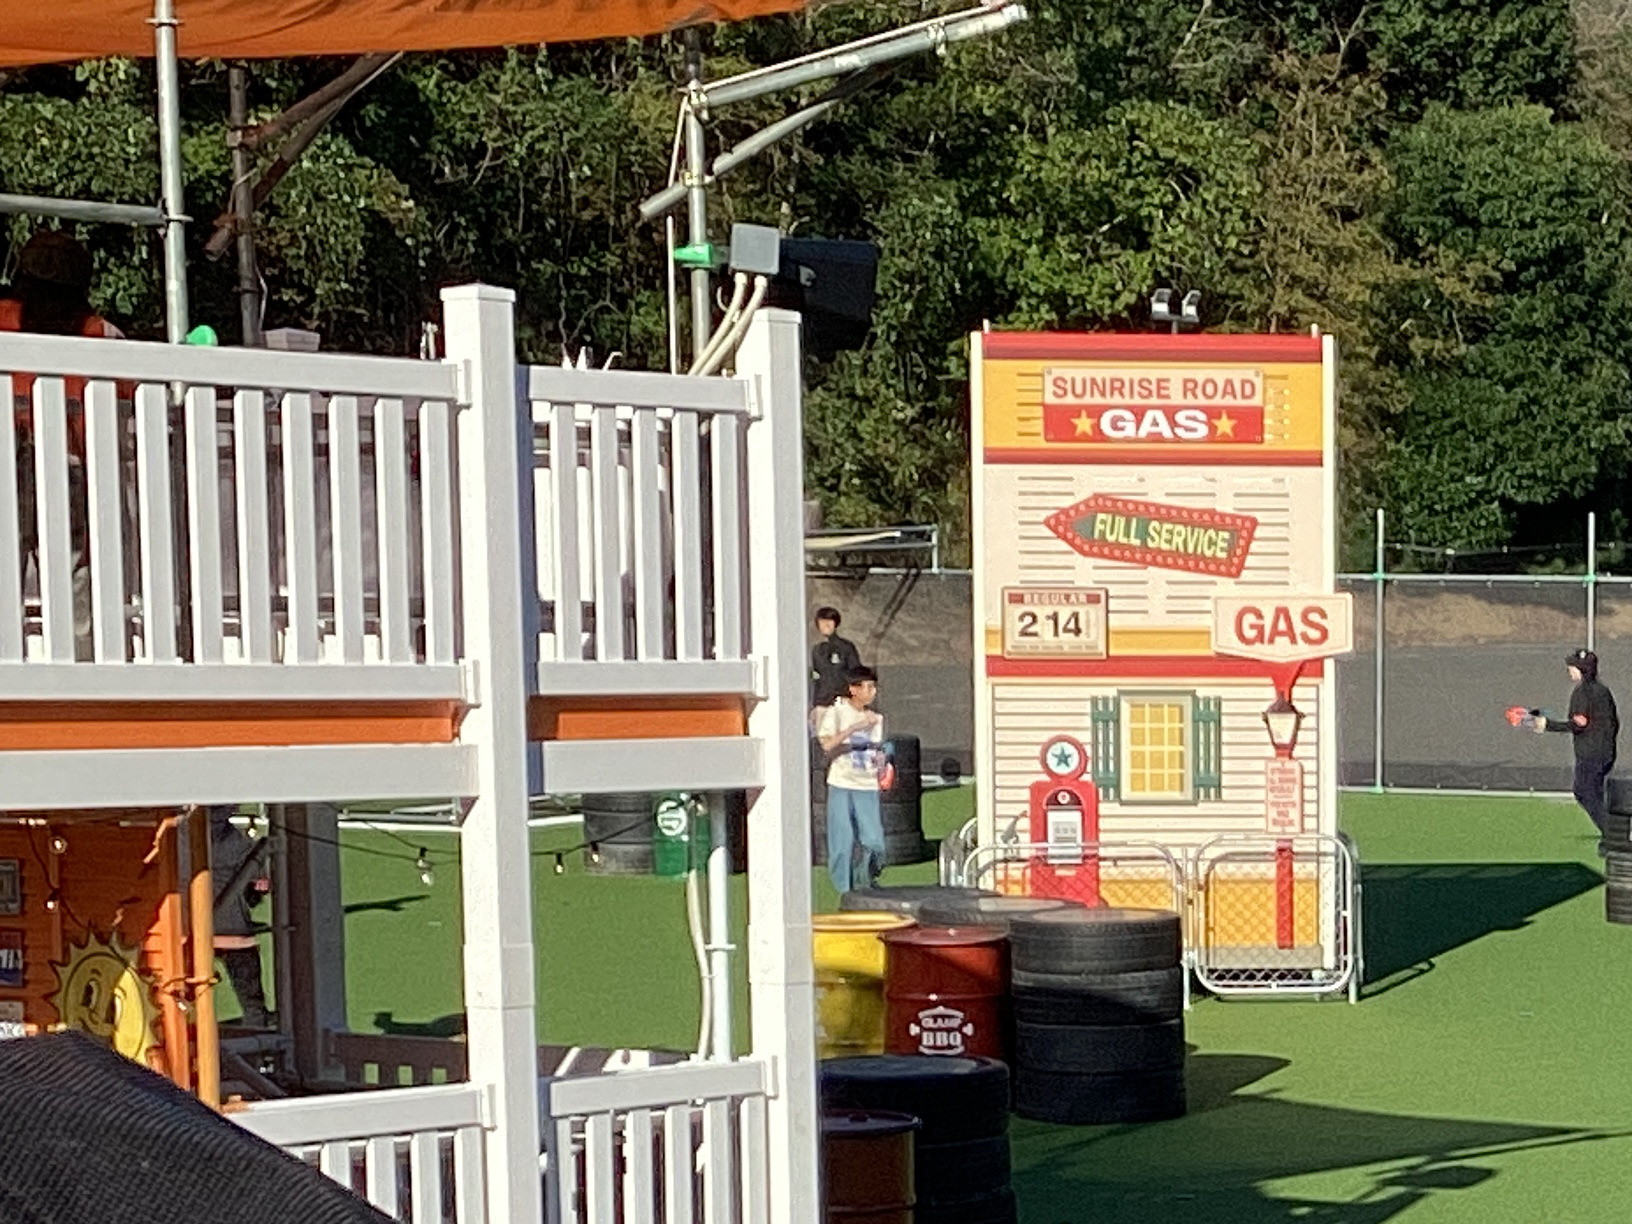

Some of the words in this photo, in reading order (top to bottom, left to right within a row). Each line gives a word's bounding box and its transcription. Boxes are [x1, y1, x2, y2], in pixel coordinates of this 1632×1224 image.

[1051, 376, 1171, 399] SUNRISE
[1182, 377, 1256, 400] ROAD
[1099, 408, 1209, 439] GAS
[1093, 512, 1142, 546] FULL
[1146, 519, 1231, 560] SERVICE
[1023, 593, 1088, 605] REGULAR
[1234, 606, 1329, 646] GAS
[921, 1031, 962, 1047] BBQ
